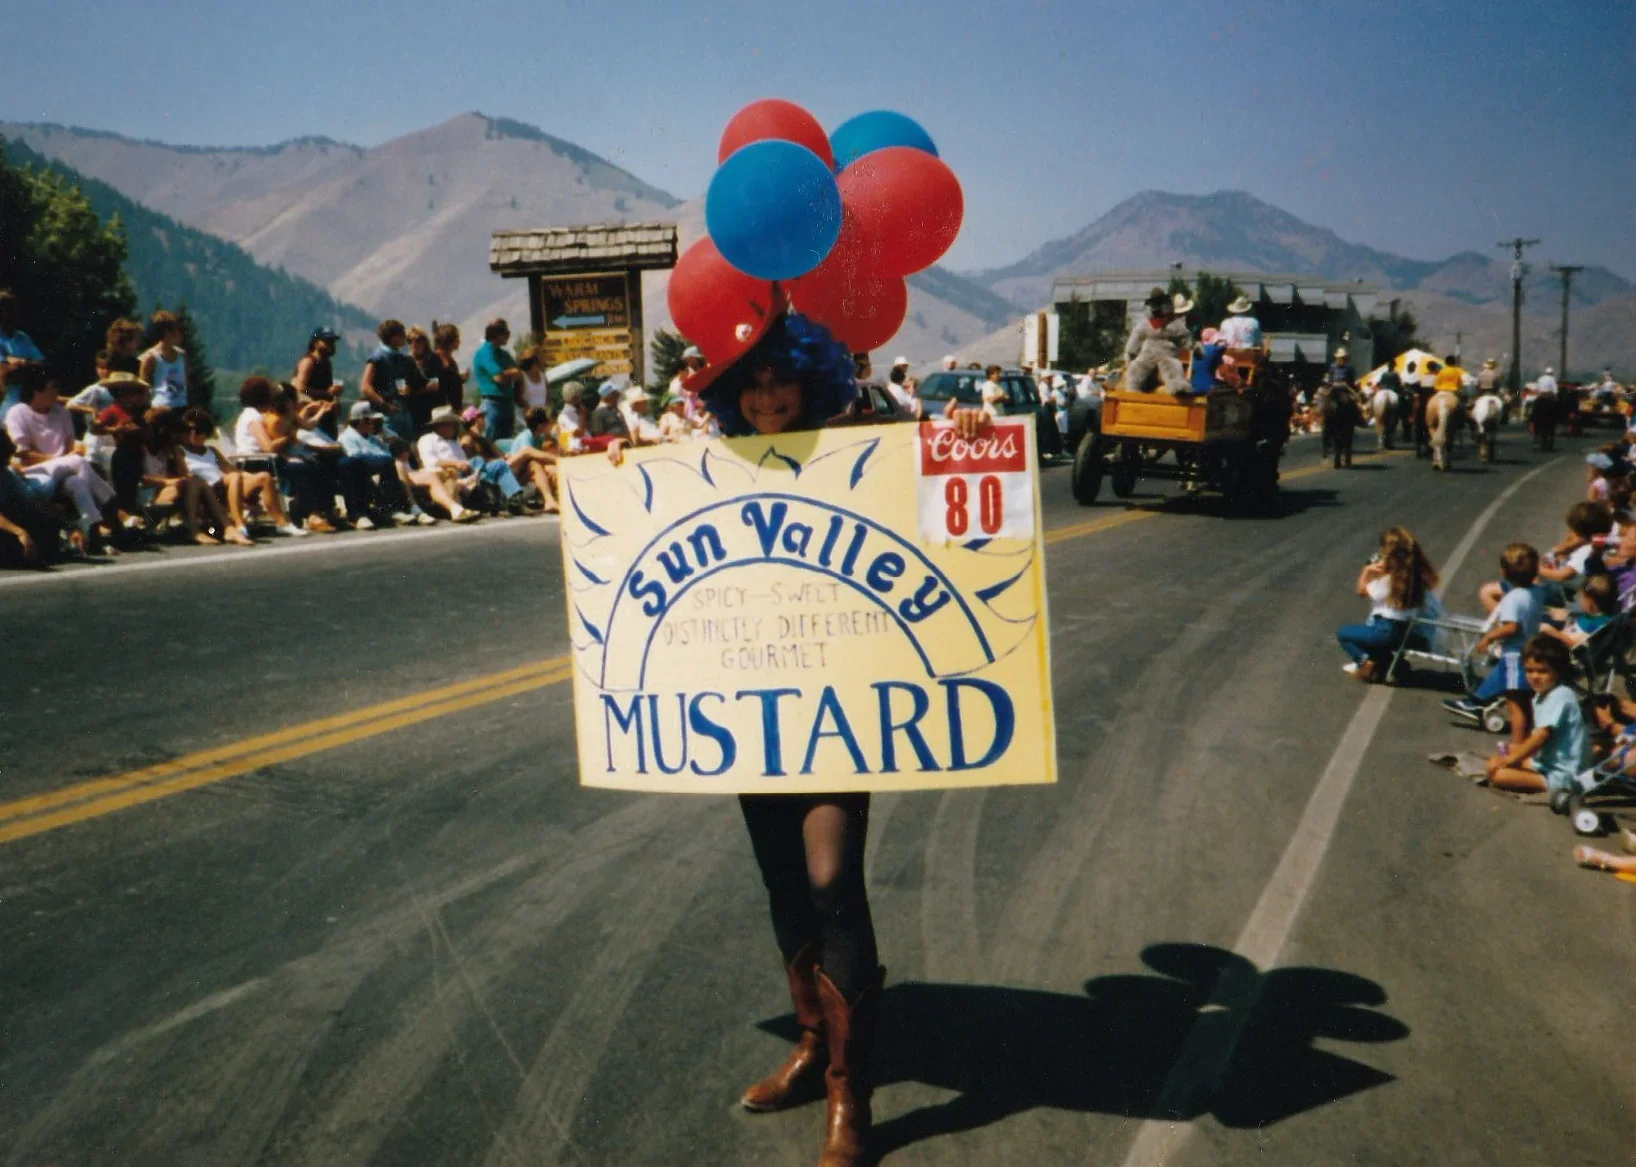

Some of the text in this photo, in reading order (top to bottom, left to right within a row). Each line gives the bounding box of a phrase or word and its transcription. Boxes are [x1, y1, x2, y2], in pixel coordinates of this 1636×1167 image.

[927, 430, 1018, 462] Coors
[945, 476, 1003, 537] 80
[628, 501, 951, 624] Sun Valley
[663, 610, 890, 646] DISTINCTLY DIFFERENT
[720, 641, 829, 671] GOURMET
[599, 677, 1015, 778] MUSTARD
